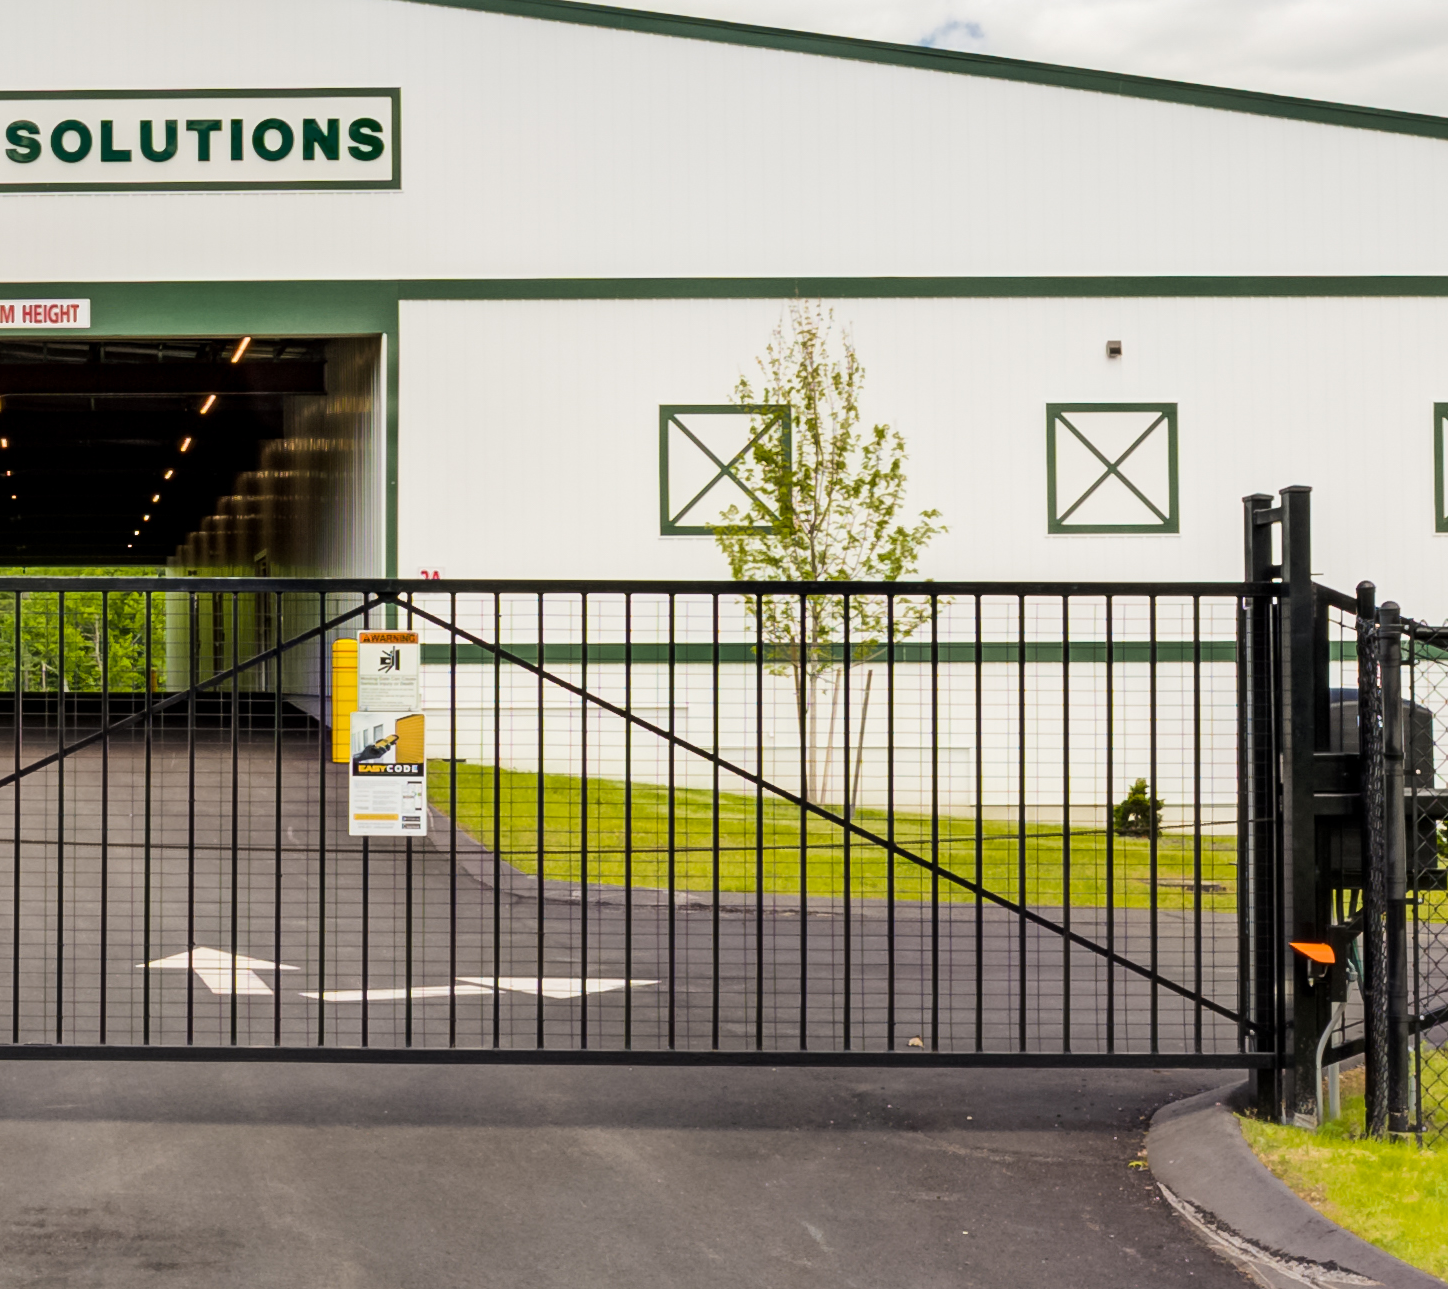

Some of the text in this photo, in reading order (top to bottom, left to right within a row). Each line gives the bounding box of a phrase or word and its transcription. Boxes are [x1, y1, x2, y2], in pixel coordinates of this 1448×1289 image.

[5, 117, 386, 164] SOLUTIONS
[22, 304, 80, 324] HEIGHT
[371, 634, 416, 643] WARNING
